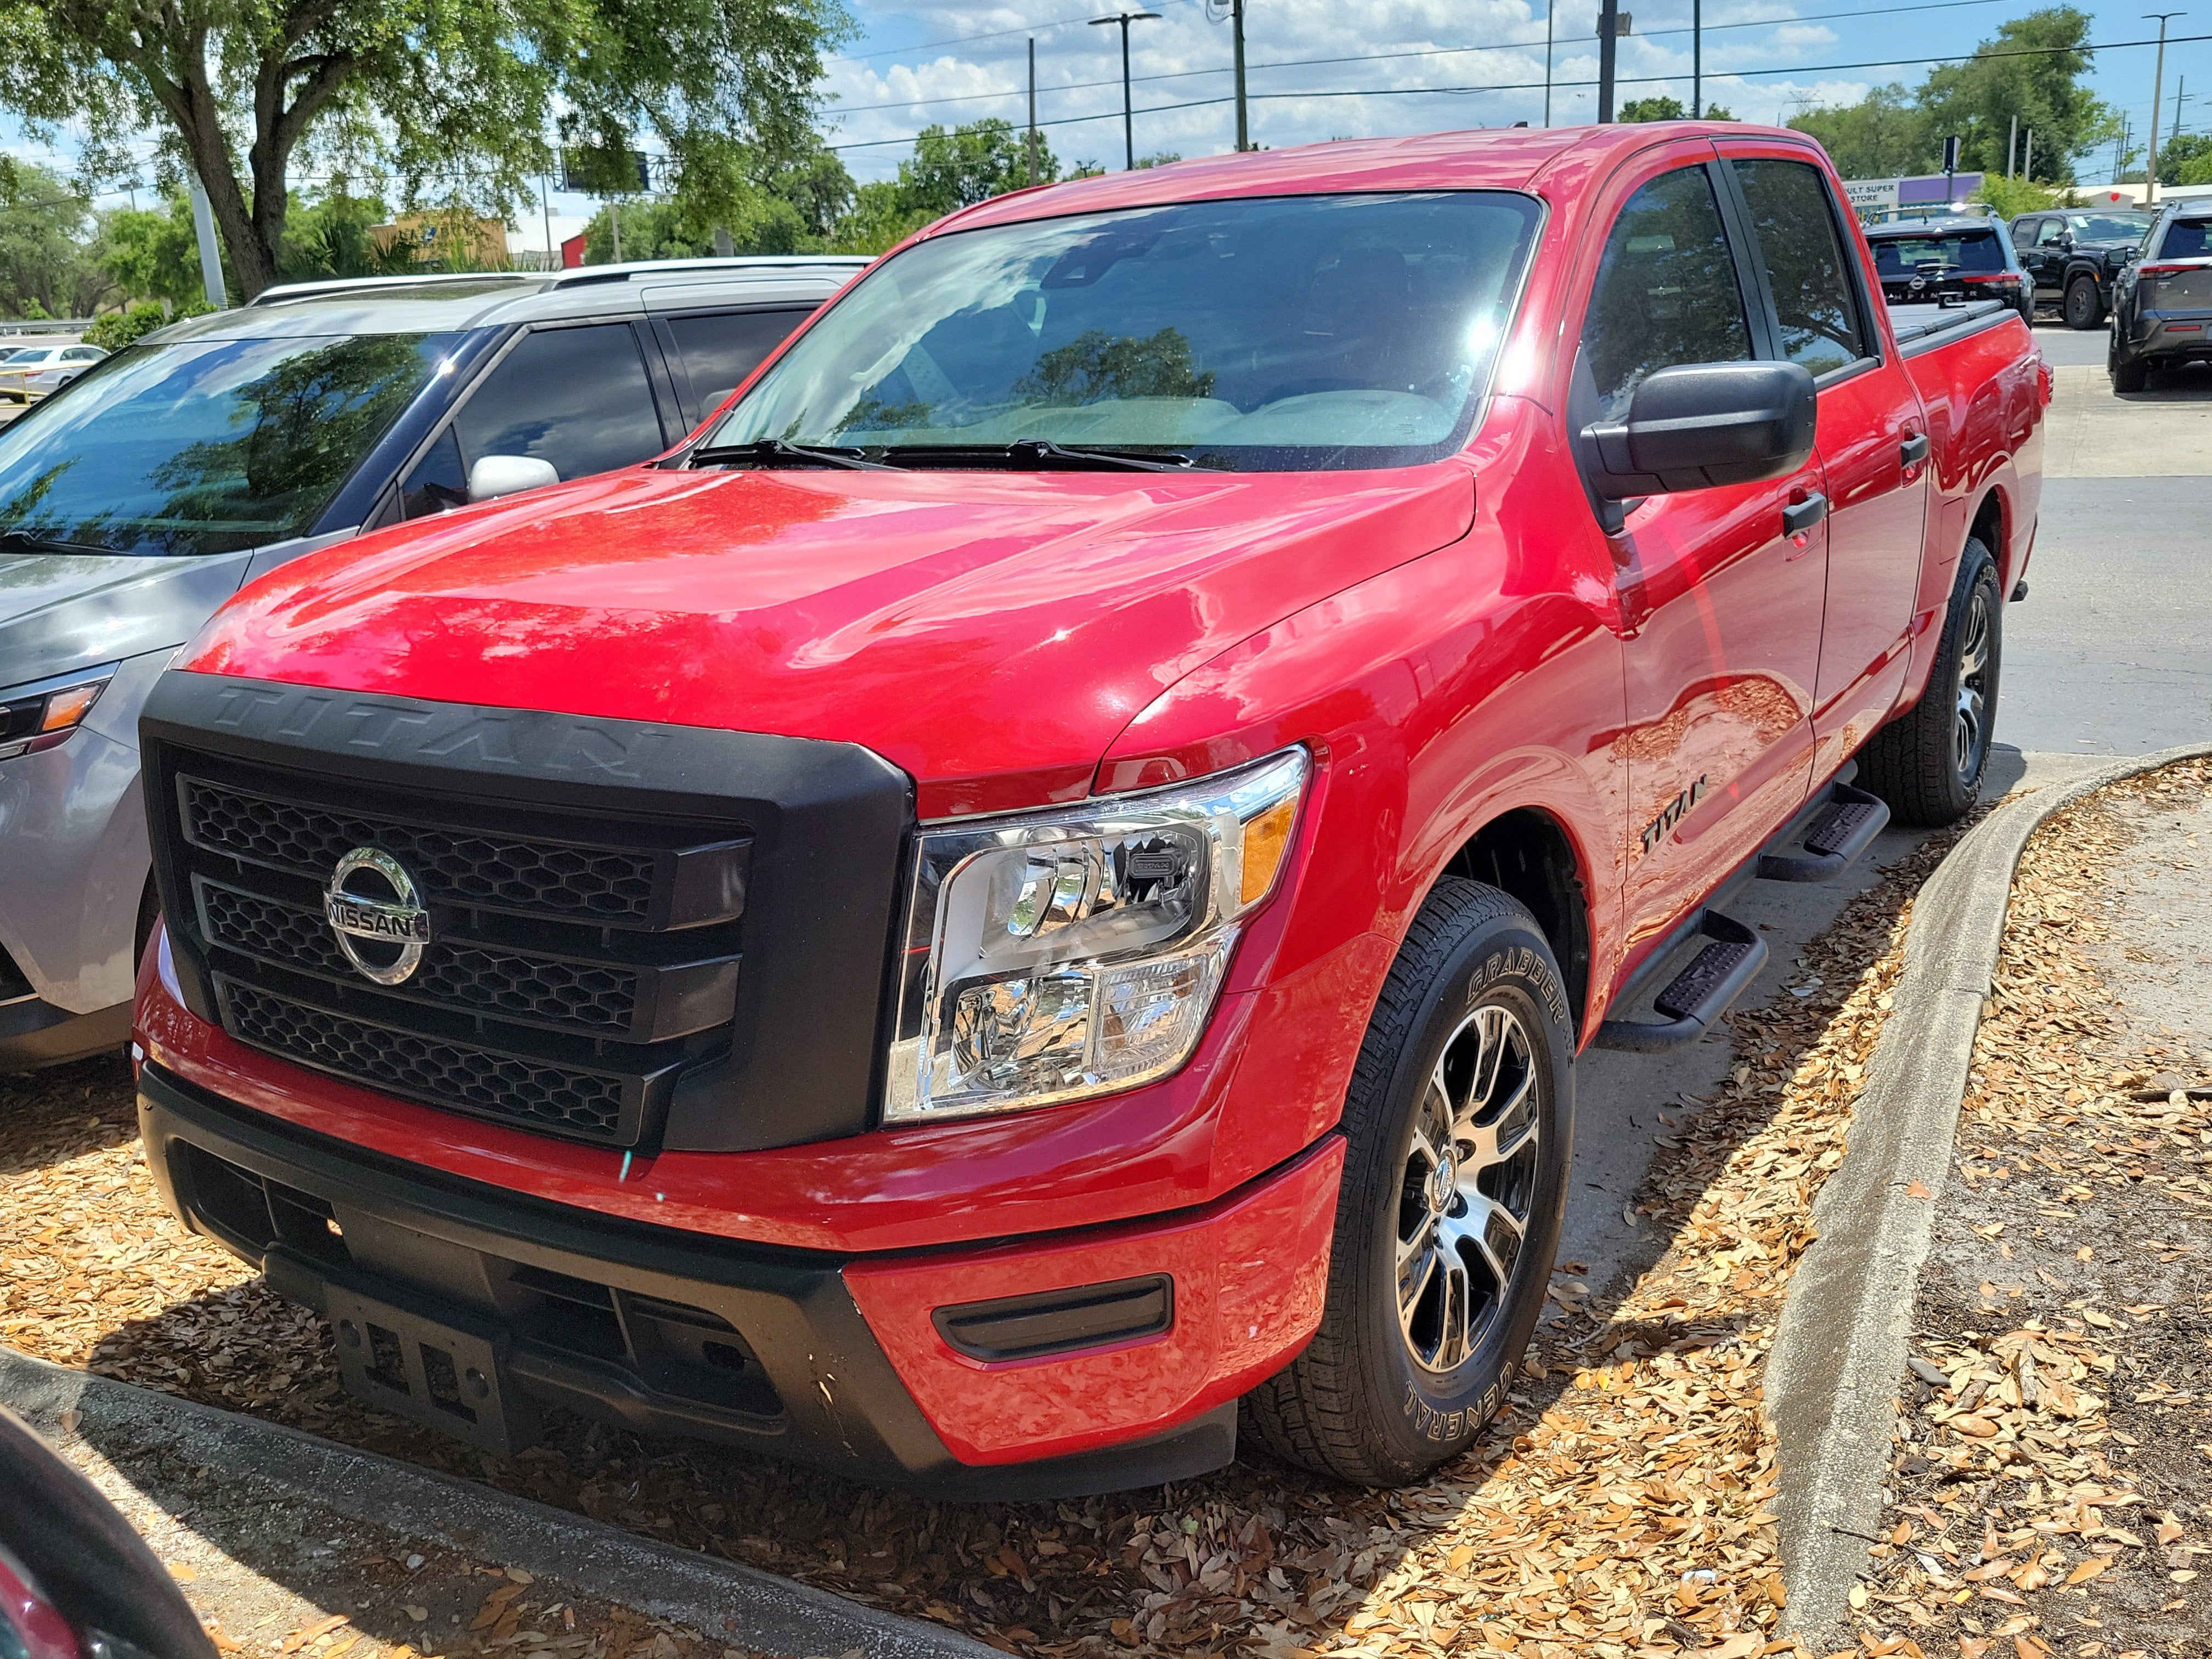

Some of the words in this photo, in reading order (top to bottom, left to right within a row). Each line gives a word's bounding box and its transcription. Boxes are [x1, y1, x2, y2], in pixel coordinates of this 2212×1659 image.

[1850, 194, 1878, 203] STORE
[214, 684, 674, 779] TITAN
[1640, 773, 1707, 855] TITAN
[329, 901, 411, 937] NISSAN
[1465, 946, 1565, 1025] GRABBER
[1403, 1362, 1513, 1441] GENERAL
